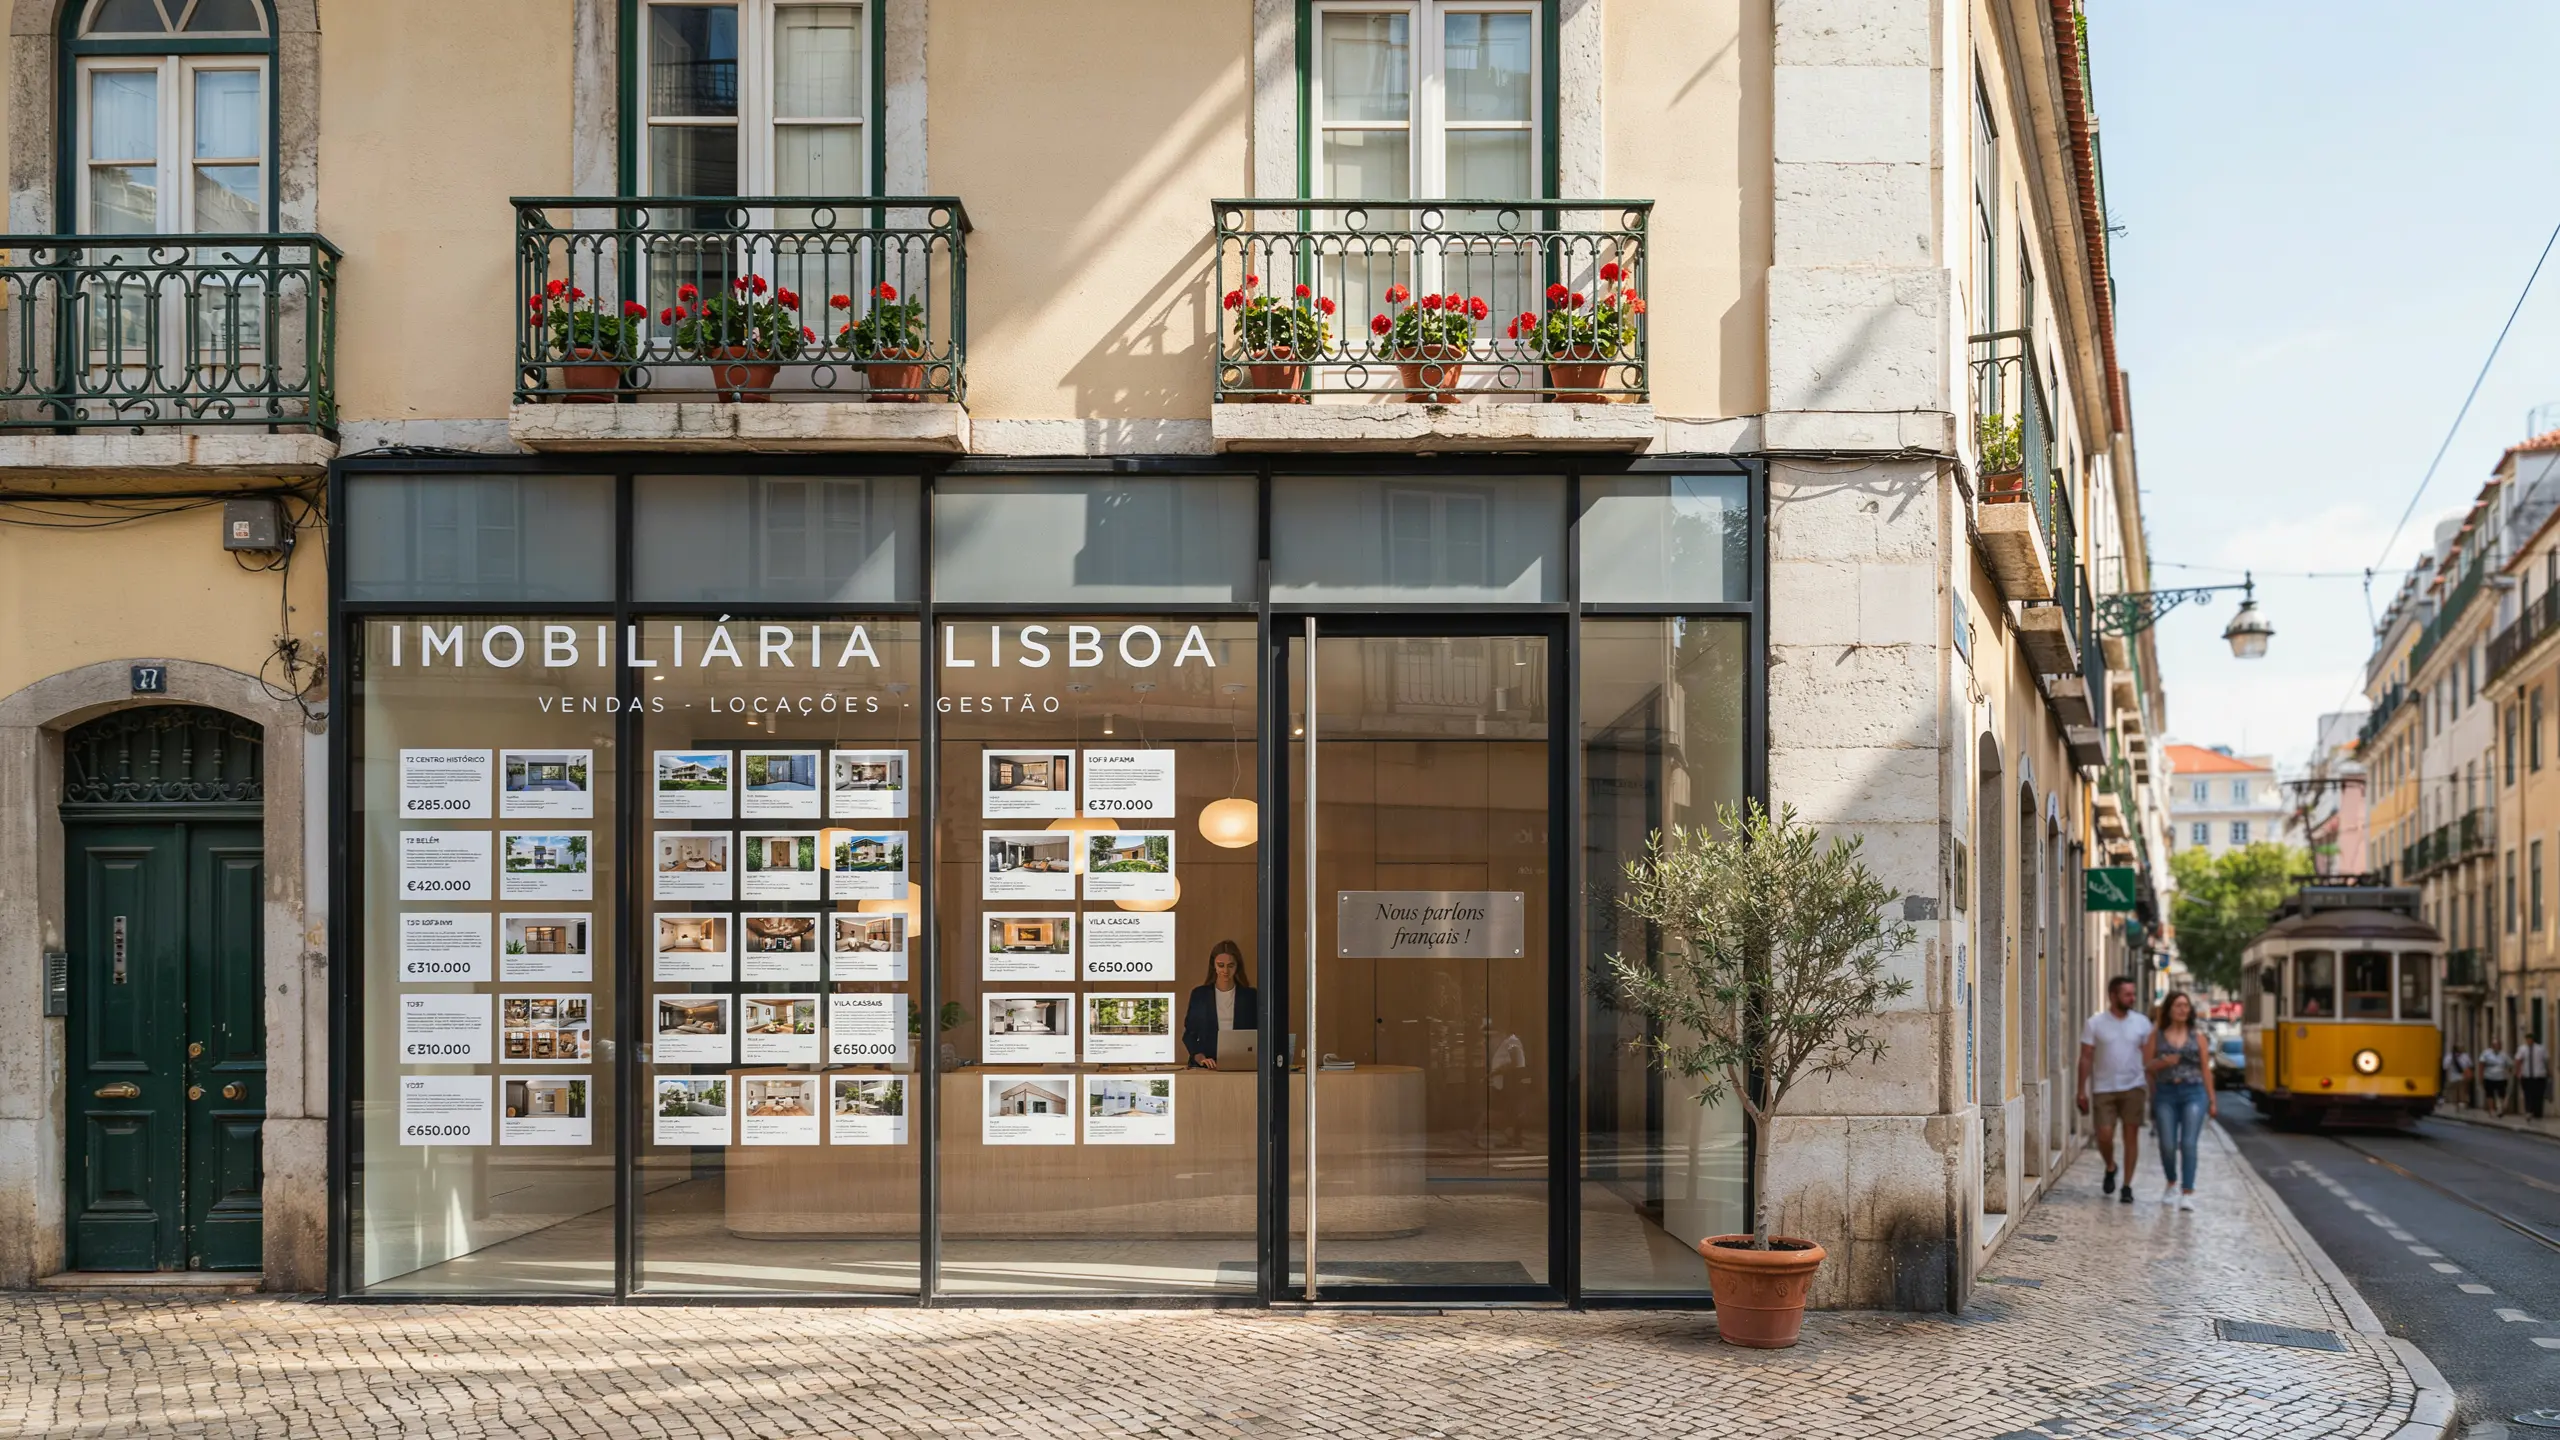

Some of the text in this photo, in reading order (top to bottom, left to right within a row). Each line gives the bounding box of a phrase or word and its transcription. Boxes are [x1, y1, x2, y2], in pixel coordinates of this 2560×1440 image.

[392, 614, 1217, 668] IMOBILIÁRIA LISBOA
[538, 696, 665, 713] VENDAS
[710, 693, 879, 717] LOCAÇÕES
[936, 693, 1060, 713] GESTÃO
[446, 754, 485, 763] HISTÓRICO
[407, 799, 471, 811] €285.000
[1088, 799, 1153, 811] €370.000
[407, 880, 471, 891] €420.000
[1375, 901, 1485, 926] Nous parlons
[1089, 918, 1106, 926] VILA
[1390, 926, 1460, 950] français
[407, 962, 471, 973] €310.000
[1088, 961, 1153, 973] €650.000
[833, 1043, 897, 1055] €650.000
[407, 1125, 471, 1136] €650.000
